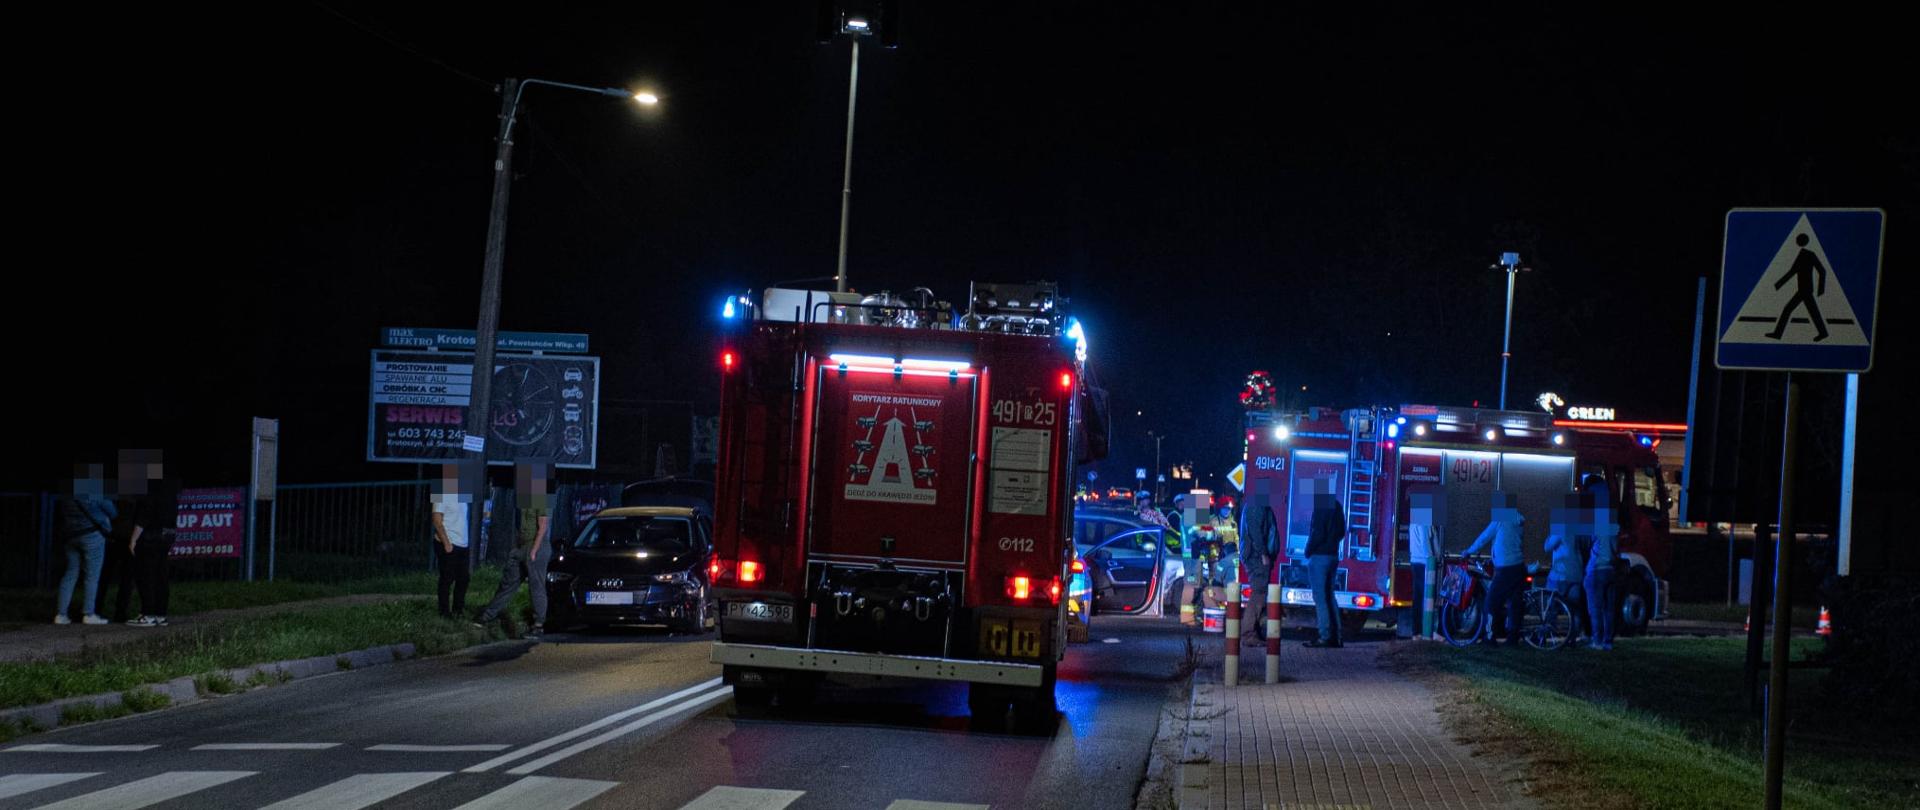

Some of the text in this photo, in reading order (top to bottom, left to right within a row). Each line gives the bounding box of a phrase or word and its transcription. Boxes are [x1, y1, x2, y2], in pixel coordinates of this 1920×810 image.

[437, 334, 476, 345] Krotos
[386, 364, 448, 372] PROSTOWANIE
[383, 384, 447, 394] OBRÓBKA CNC
[852, 394, 942, 407] KORYTARZ RATUNKOWY
[385, 405, 517, 426] SERWIS LG
[1567, 406, 1615, 420] ORLEN
[398, 427, 421, 439] 603
[423, 428, 444, 440] 743
[176, 512, 233, 528] UP AUT
[1011, 537, 1034, 552] 112
[730, 604, 790, 619] PY 42598
